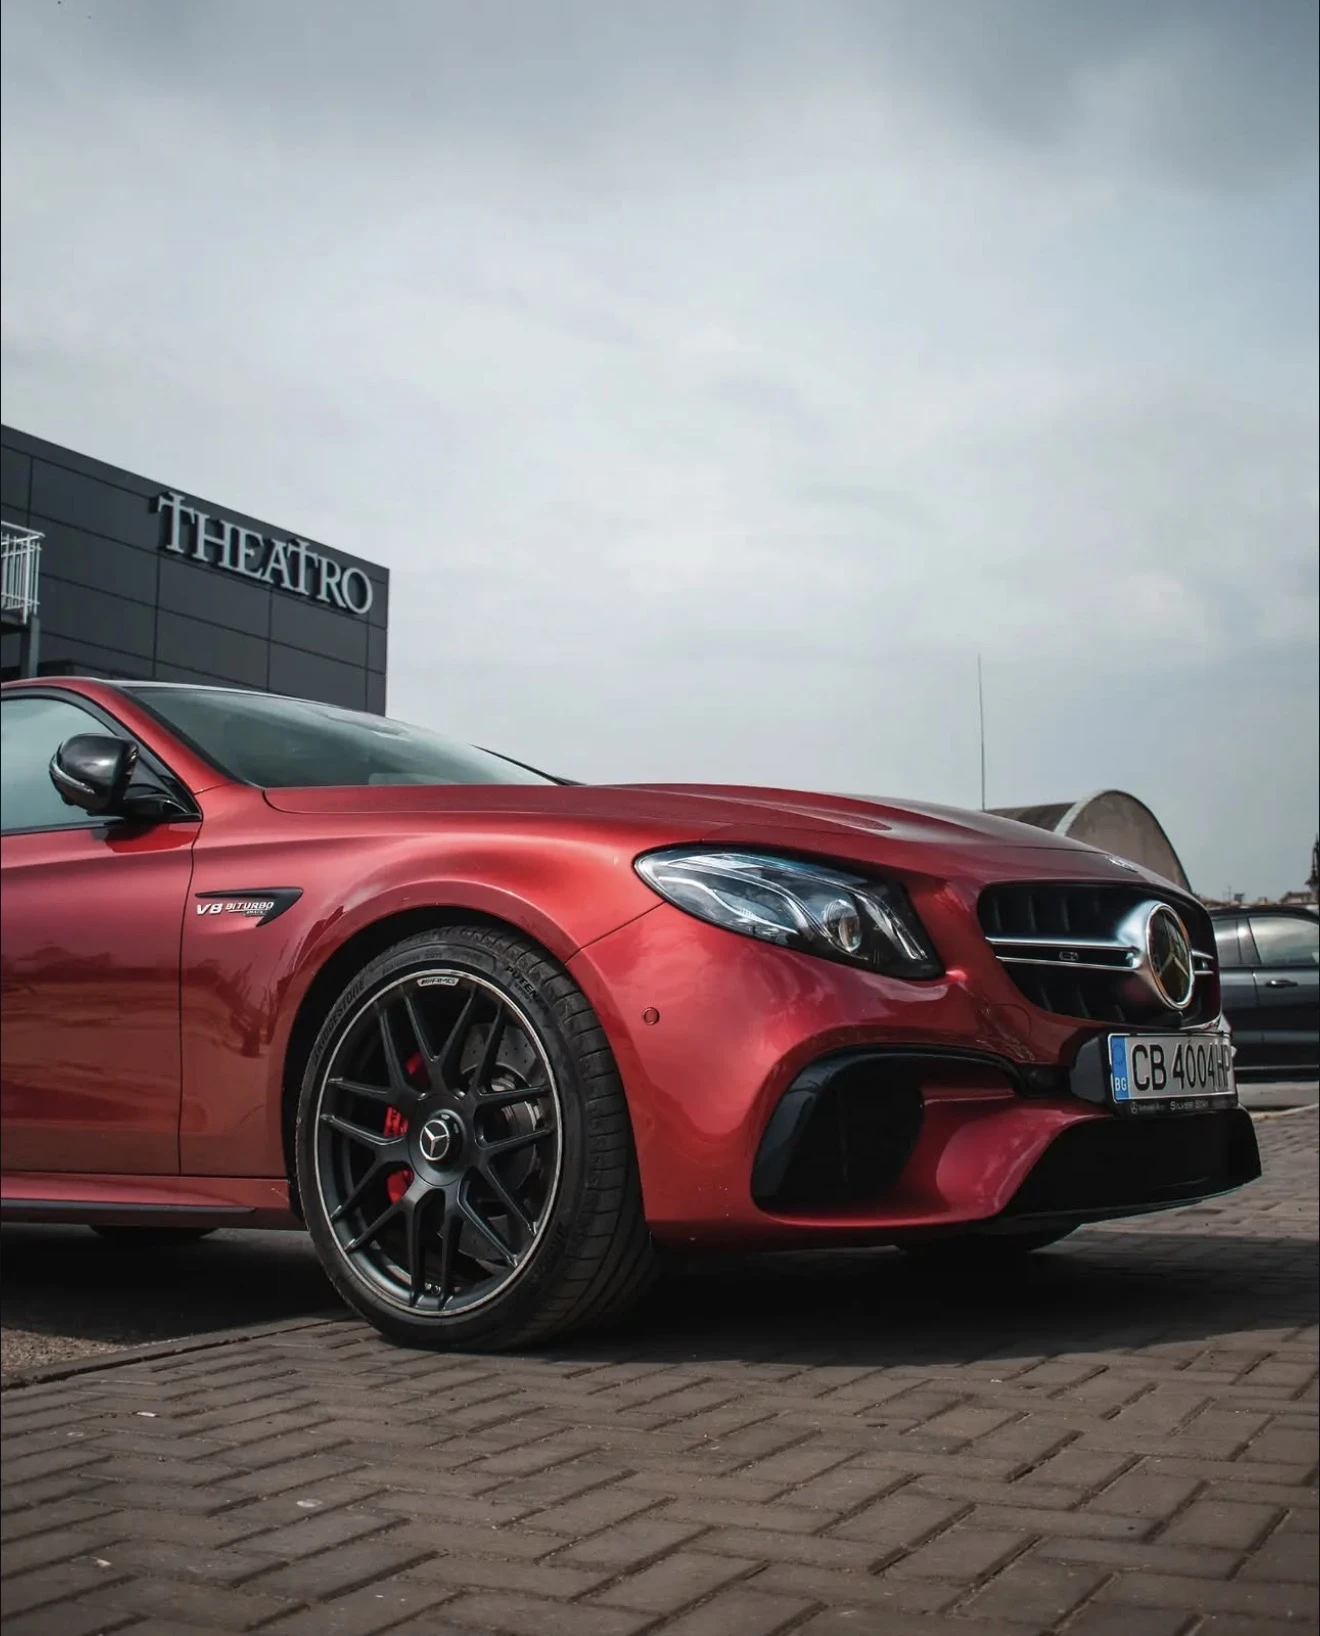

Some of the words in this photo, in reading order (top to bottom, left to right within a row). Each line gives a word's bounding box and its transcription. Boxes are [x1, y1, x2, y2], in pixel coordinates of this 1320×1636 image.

[158, 491, 372, 614] THEATRO
[197, 903, 223, 914] V8
[225, 902, 274, 911] BITURBO
[1132, 1044, 1167, 1091] CB
[1114, 1077, 1128, 1091] BG
